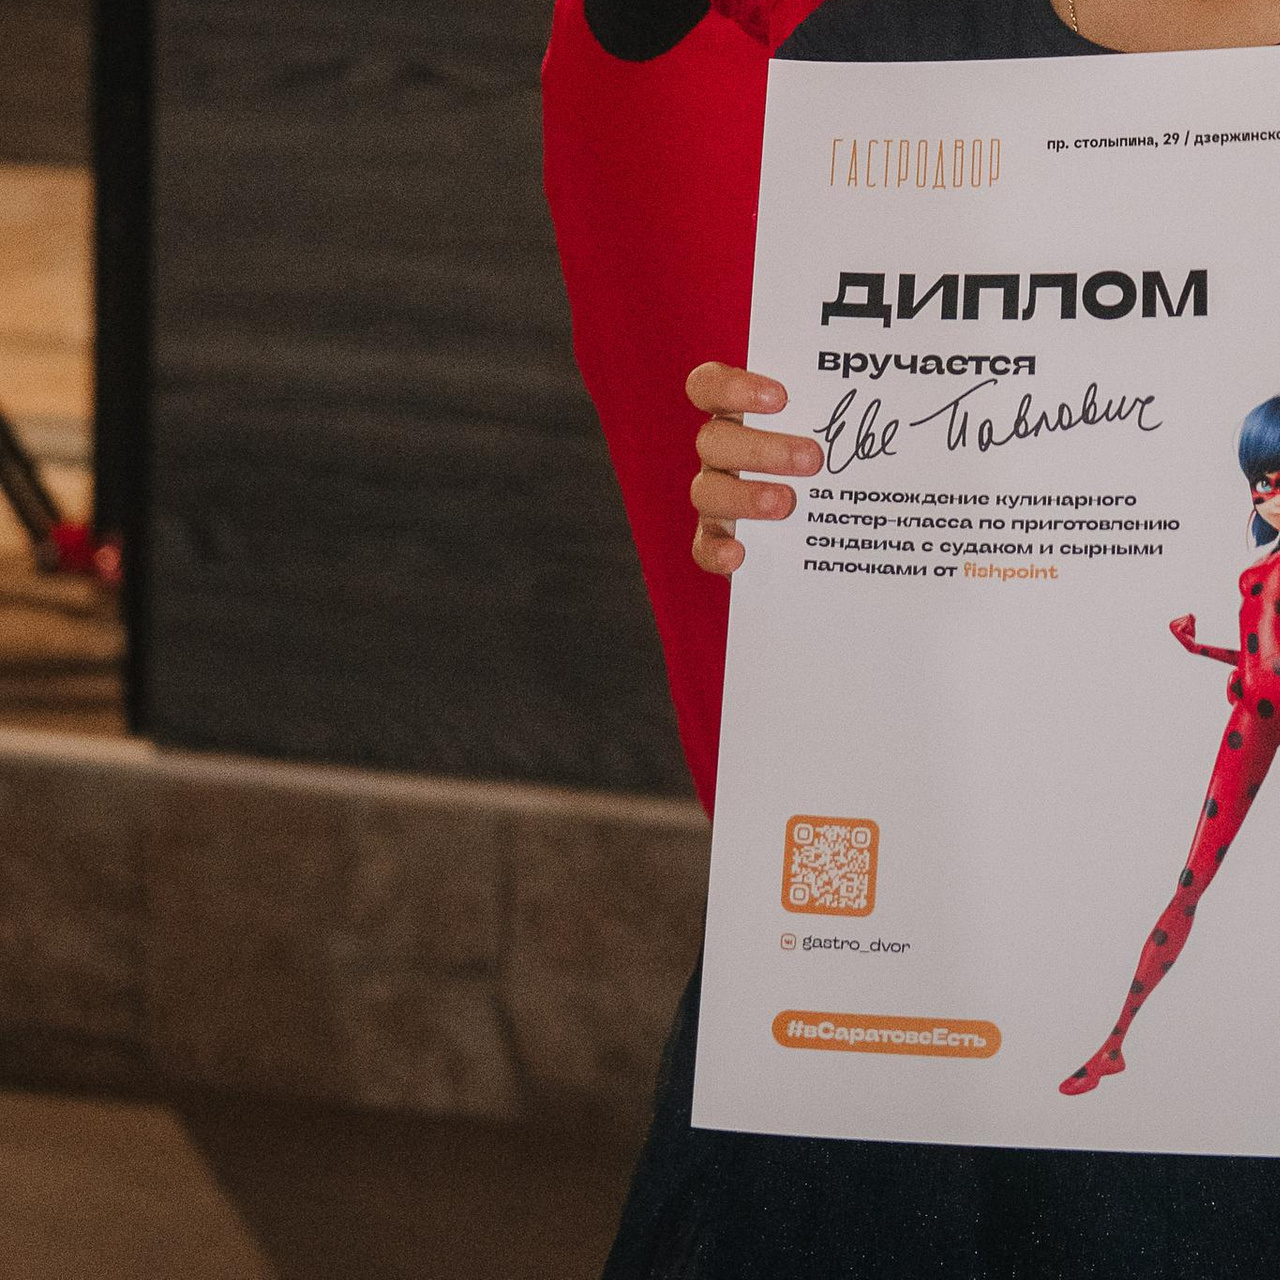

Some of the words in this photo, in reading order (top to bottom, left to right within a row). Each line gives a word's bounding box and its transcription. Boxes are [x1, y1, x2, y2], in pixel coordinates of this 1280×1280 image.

[1047, 138, 1069, 152] пр.
[1074, 134, 1158, 149] столыпина,
[1163, 132, 1180, 145] 29
[1184, 130, 1190, 146] /
[830, 138, 1000, 189] ГАСТРОДВОР
[821, 269, 1208, 328] ДИПЛОМ
[817, 351, 1036, 379] вручается
[814, 388, 900, 474] Еве
[809, 488, 834, 501] за
[840, 489, 990, 506] прохождение
[996, 493, 1137, 509] кулинарного
[807, 511, 973, 530] мастер-класса
[979, 520, 1005, 531] по
[1011, 520, 1180, 533] приготовлению
[805, 536, 916, 553] сэндвича
[921, 541, 933, 552] с
[940, 541, 1033, 556] судаком
[1039, 543, 1053, 555] и
[1060, 543, 1163, 557] сырными
[803, 559, 928, 577] палочками
[934, 566, 957, 578] от
[963, 562, 1059, 582] fishpoint
[802, 935, 911, 954] gastro_dvor
[786, 1019, 987, 1049] #вСаратовеЕсть
